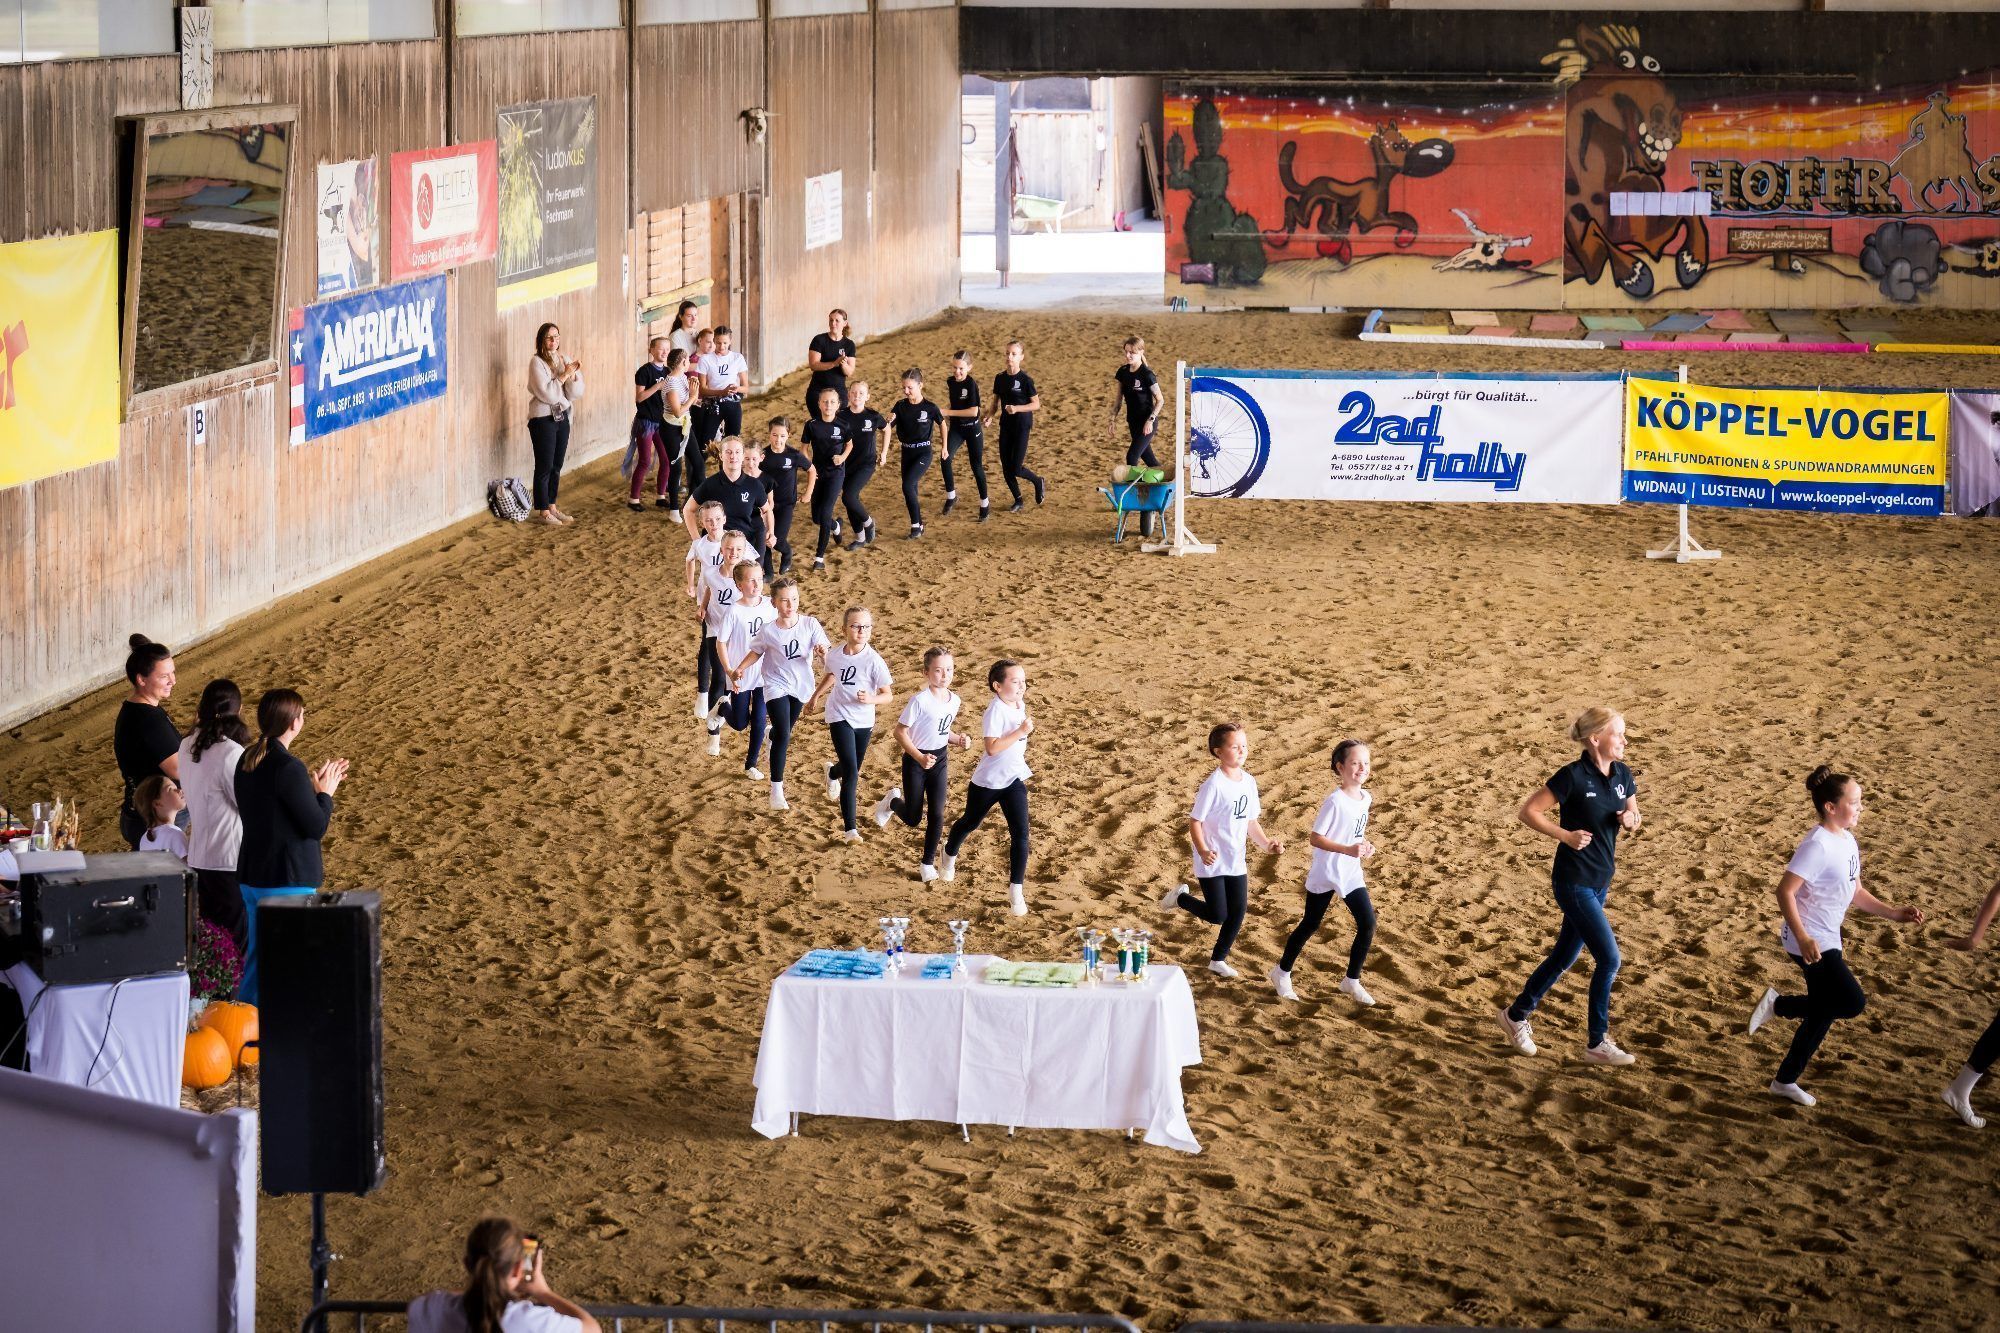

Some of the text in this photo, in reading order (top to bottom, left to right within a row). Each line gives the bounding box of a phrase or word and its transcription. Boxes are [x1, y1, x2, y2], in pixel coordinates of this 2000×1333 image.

[1691, 157, 1901, 213] HOFER
[1453, 390, 1472, 401] für
[195, 409, 204, 435] B
[1637, 392, 1936, 442] KÖPPEL-VOGEL
[916, 440, 931, 448] PRO
[1330, 463, 1344, 471] Tel.
[1635, 450, 1936, 476] PFAHLFUNDATIONEN & SPUNDWANDRAMMUNGEN
[1330, 473, 1406, 482] www.2radholly.at
[1633, 480, 1935, 508] WIDNAU LUSTENAU www.koeppel-vogel.com
